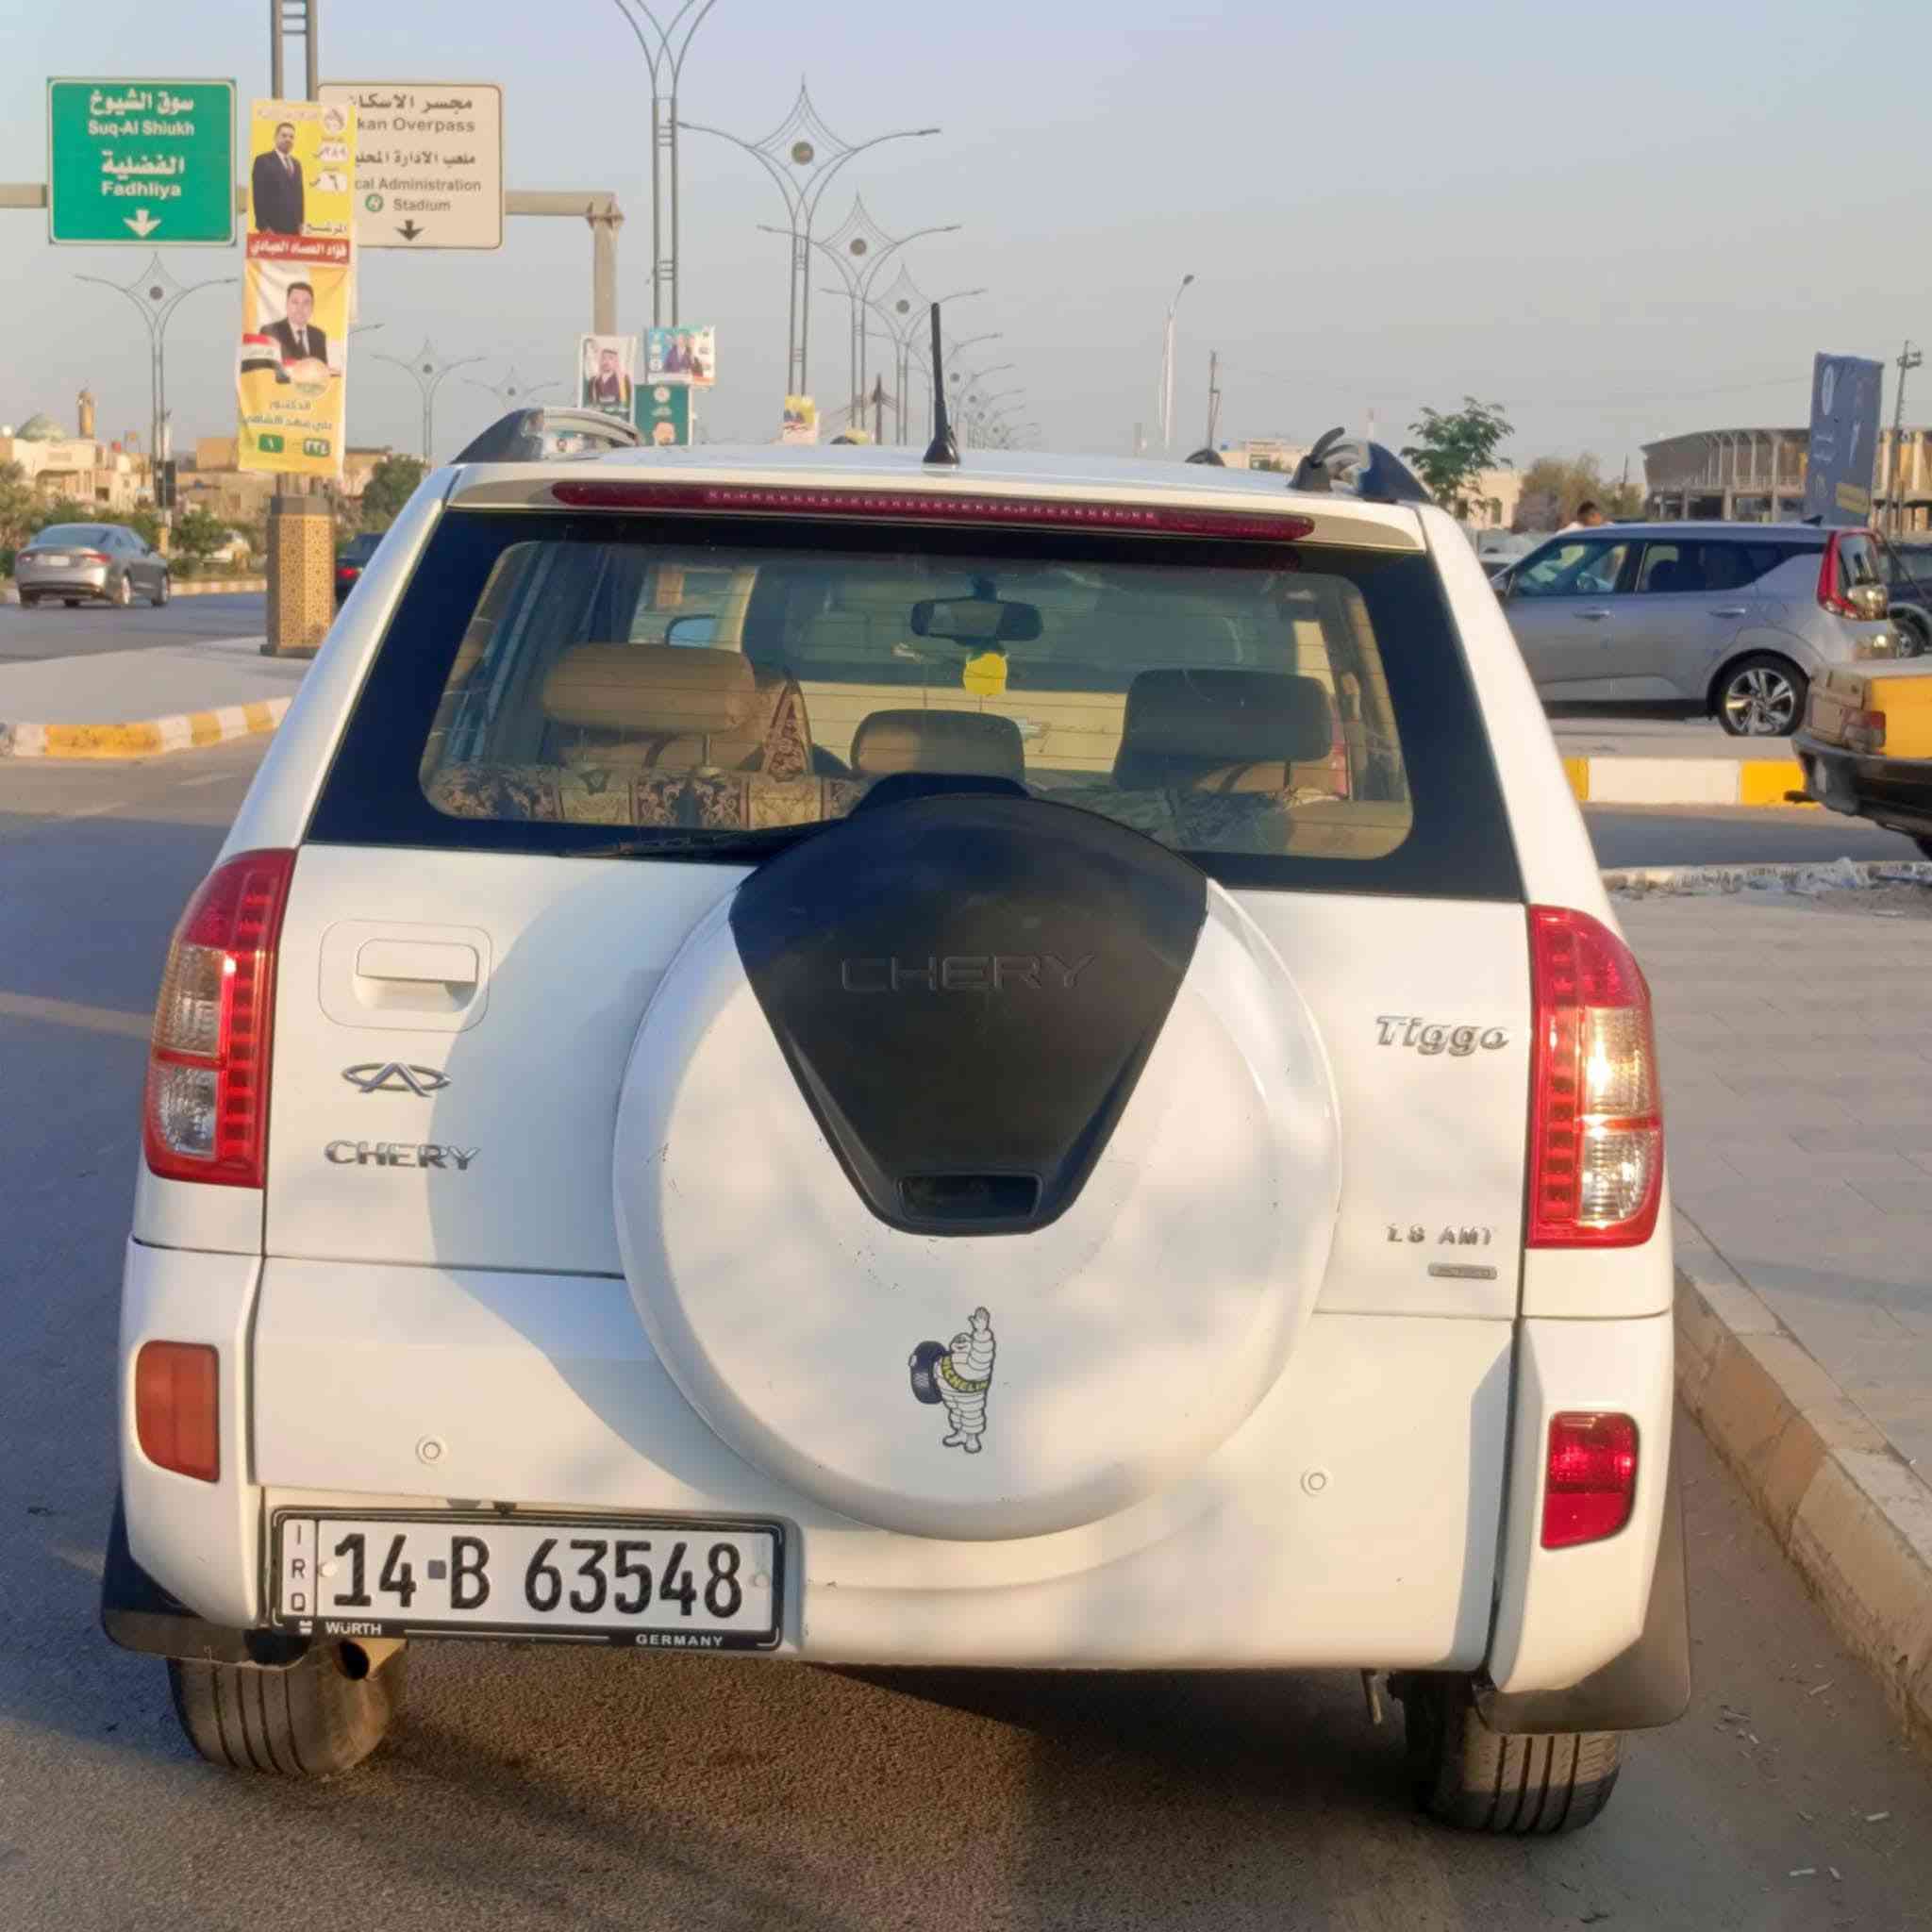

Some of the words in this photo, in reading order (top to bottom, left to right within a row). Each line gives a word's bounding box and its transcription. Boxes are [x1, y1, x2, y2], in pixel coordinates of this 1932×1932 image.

[90, 88, 153, 116] الشيوخ
[157, 91, 194, 115] سوق
[422, 98, 473, 115] مجسر
[142, 120, 195, 136] Shiukh
[357, 118, 387, 131] kan
[392, 117, 476, 134] Overpass
[101, 149, 186, 181] الفضلية
[355, 151, 390, 170] المحلي
[441, 154, 476, 169] ملعب
[101, 181, 183, 200] Fadhliya
[355, 178, 375, 191] cal
[378, 177, 482, 192] Administration
[392, 198, 452, 212] Stadium
[841, 953, 1096, 991] CHERY
[1376, 1015, 1509, 1057] Tiggo
[325, 1140, 481, 1171] CHERY
[525, 1538, 742, 1618] 63548
[635, 1633, 724, 1647] GERMANY
